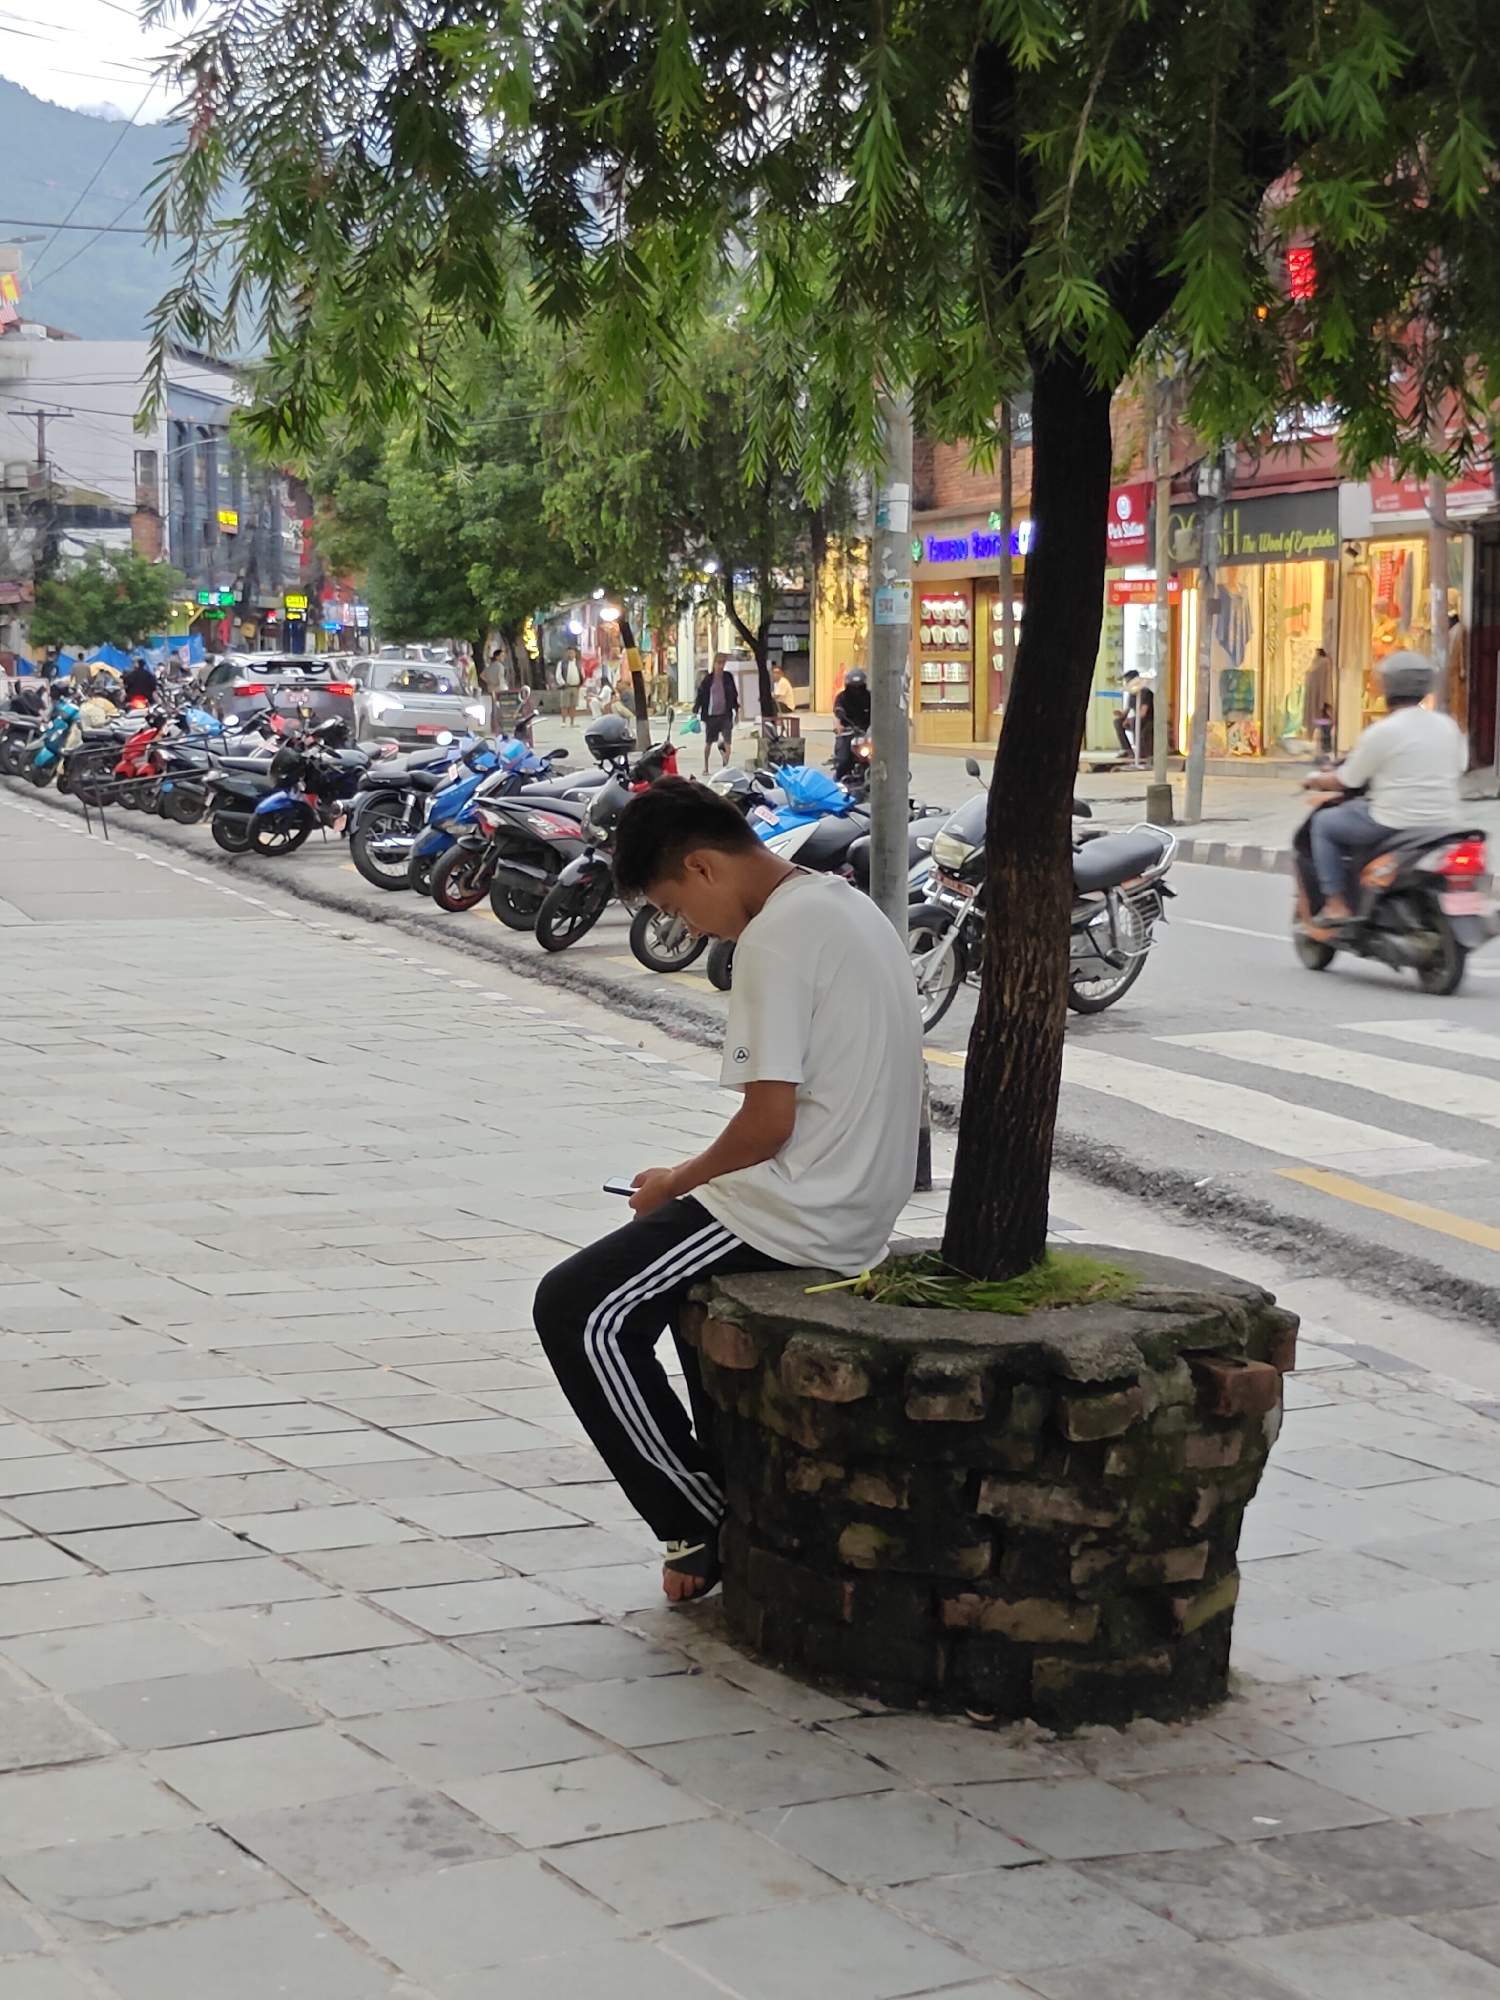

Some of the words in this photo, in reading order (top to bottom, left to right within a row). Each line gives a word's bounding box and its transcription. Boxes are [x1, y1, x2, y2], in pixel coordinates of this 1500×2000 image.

[1242, 533, 1256, 553] The
[1259, 531, 1284, 553] Wool
[1284, 530, 1295, 559] of
